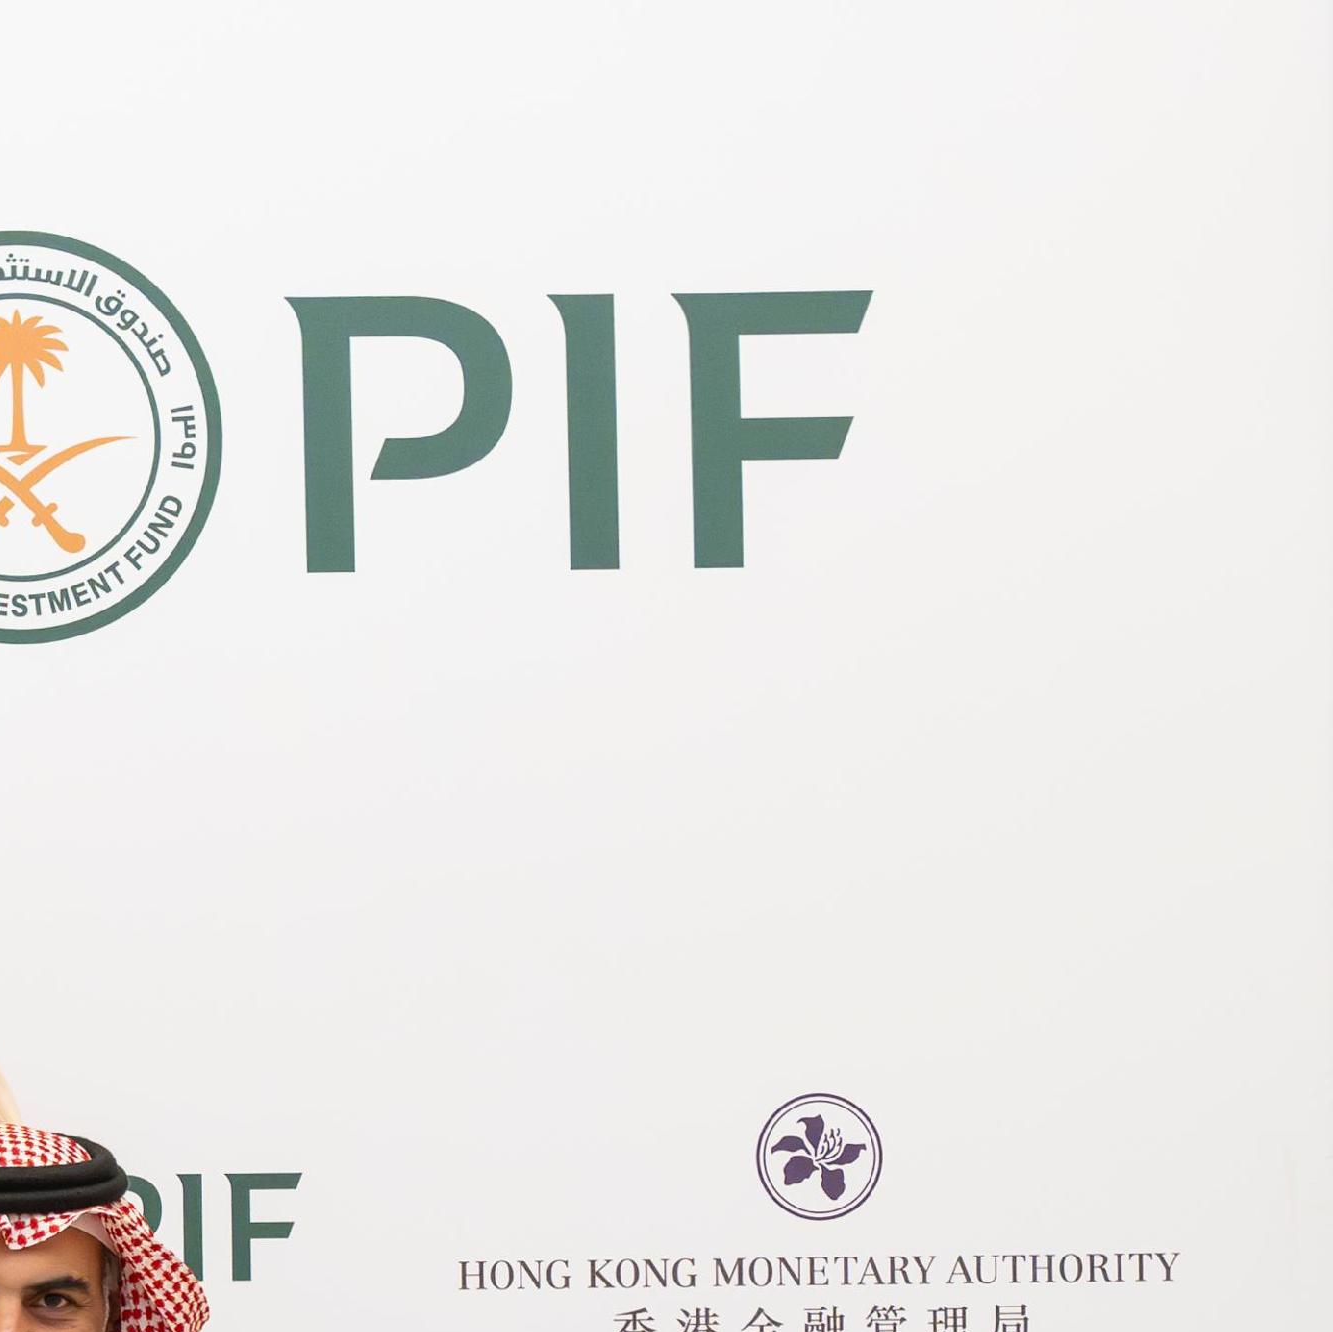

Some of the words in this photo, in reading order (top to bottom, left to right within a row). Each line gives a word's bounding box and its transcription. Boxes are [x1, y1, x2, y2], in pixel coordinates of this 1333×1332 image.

[96, 290, 171, 377] صندوق
[284, 290, 873, 573] PIF
[123, 495, 182, 570] FUND
[459, 1260, 571, 1290] HONG
[588, 1258, 697, 1288] KONG
[714, 1256, 936, 1286] MONETARY
[946, 1253, 1179, 1283] AUTHORITY
